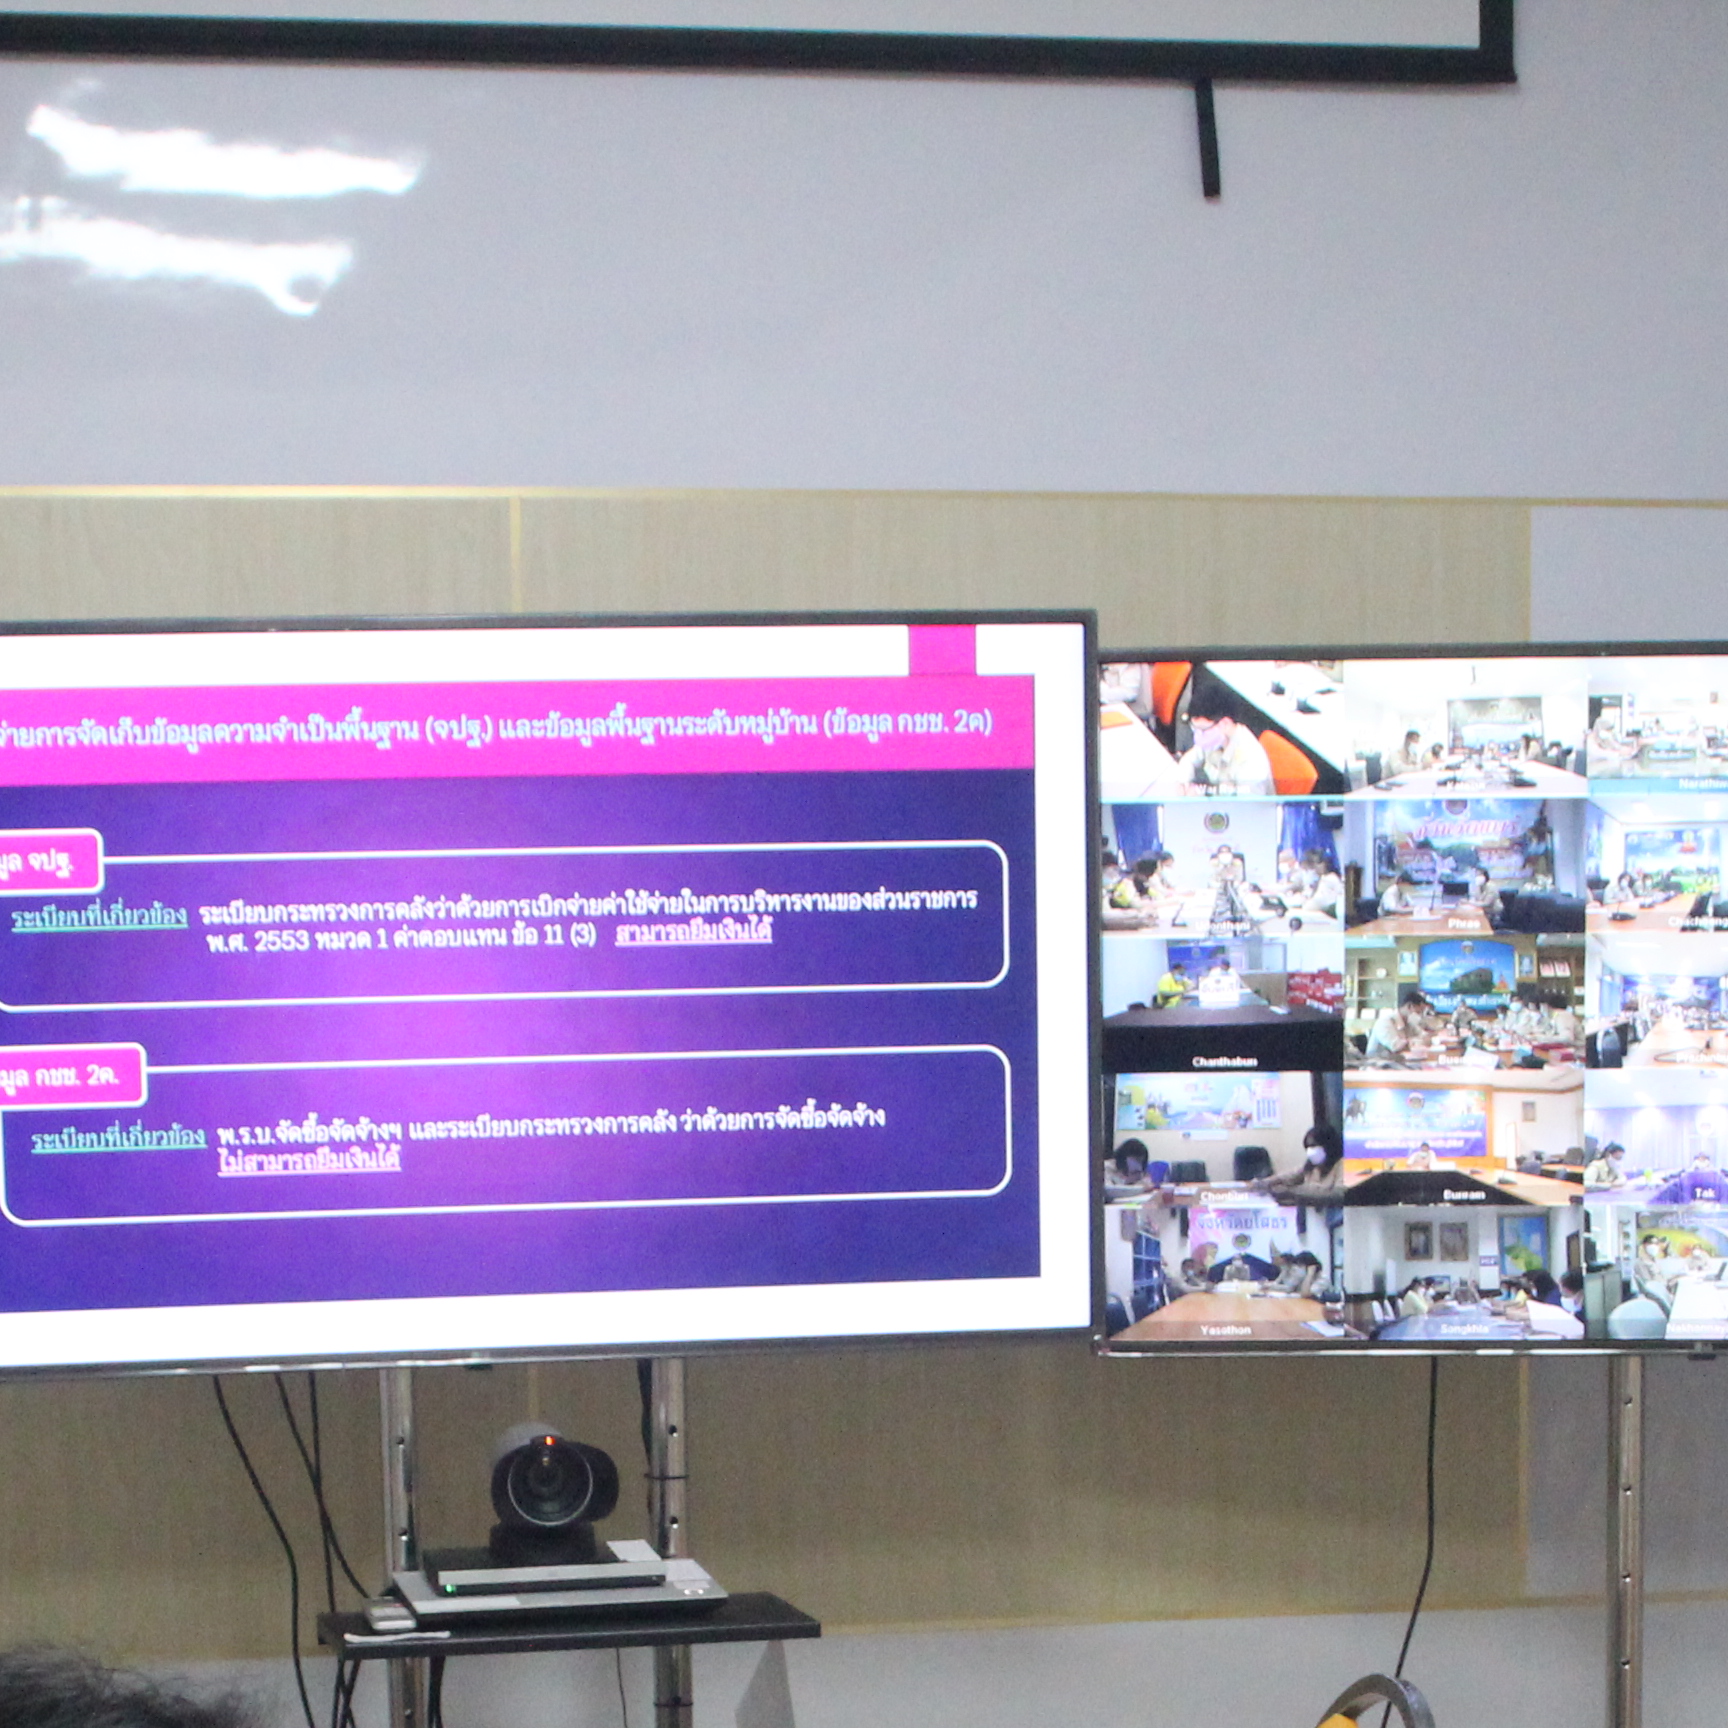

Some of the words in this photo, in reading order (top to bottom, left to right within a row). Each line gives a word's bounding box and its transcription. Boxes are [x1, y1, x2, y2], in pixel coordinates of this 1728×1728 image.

[1448, 918, 1482, 929] Phrae
[255, 929, 309, 951] 2553
[316, 928, 372, 950] หมวด
[377, 927, 389, 949] 1
[394, 923, 508, 950] ค่าตอบแทน
[512, 919, 539, 946] ข้อ
[543, 924, 564, 946] 11
[570, 922, 597, 948] (3)
[1695, 1187, 1716, 1199] Tak
[1200, 1324, 1252, 1336] Yasothon
[1440, 1323, 1490, 1336] Songkhla
